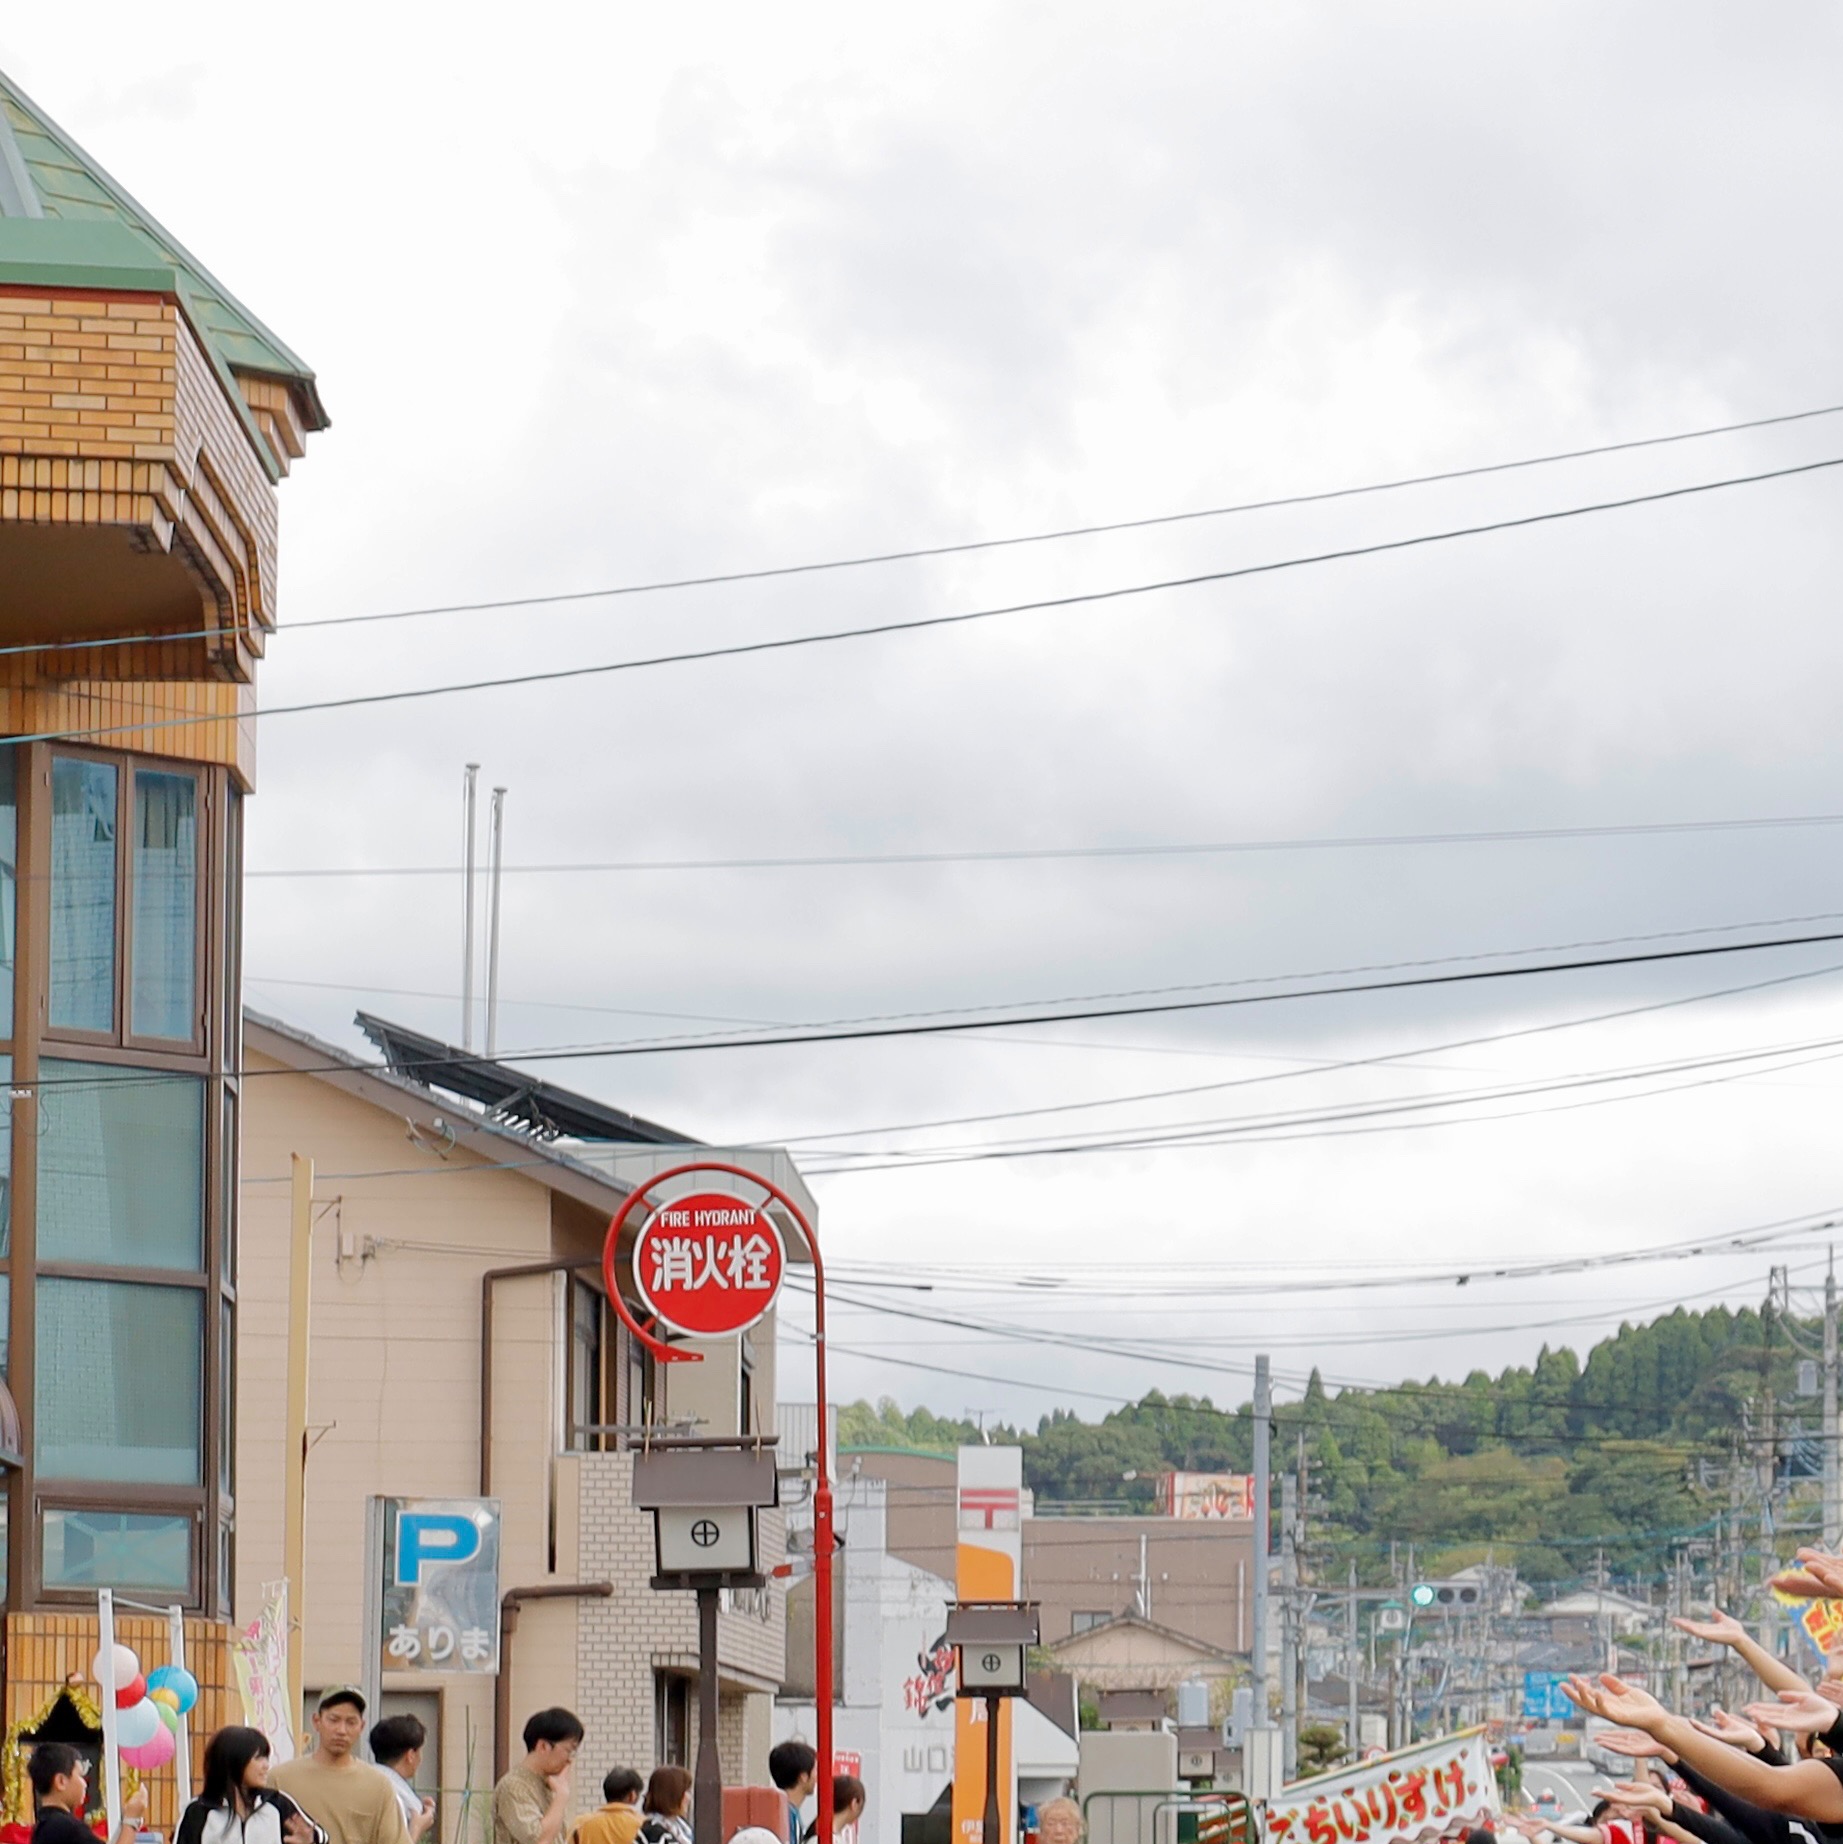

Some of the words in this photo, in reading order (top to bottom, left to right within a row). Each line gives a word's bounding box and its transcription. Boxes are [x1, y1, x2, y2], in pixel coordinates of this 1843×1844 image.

[660, 1211, 690, 1228] FIRE
[695, 1209, 756, 1226] HYDRANT
[650, 1233, 772, 1292] 消火栓
[396, 1511, 481, 1586] P
[388, 1623, 489, 1661] ありま
